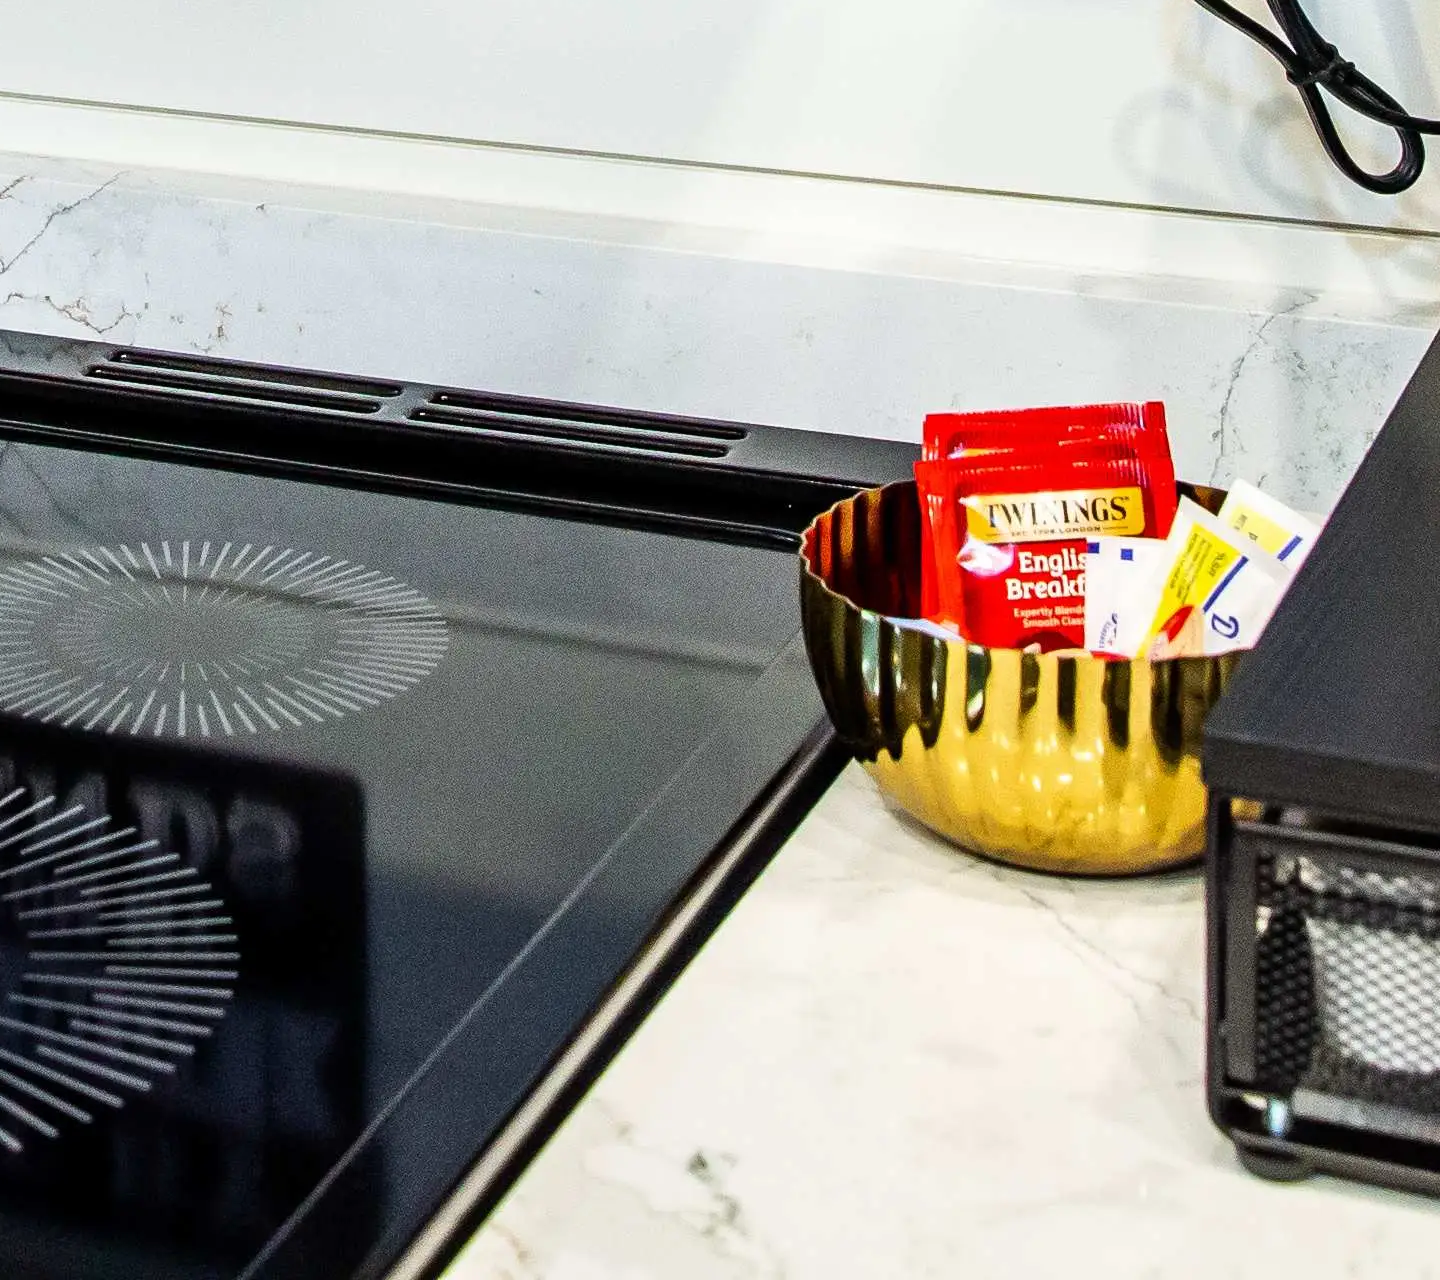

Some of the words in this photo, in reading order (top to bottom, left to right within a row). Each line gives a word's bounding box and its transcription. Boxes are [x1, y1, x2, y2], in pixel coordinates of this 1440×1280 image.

[984, 495, 1128, 529] TWININGS
[1018, 547, 1087, 578] Englis
[1005, 572, 1087, 601] Breakf
